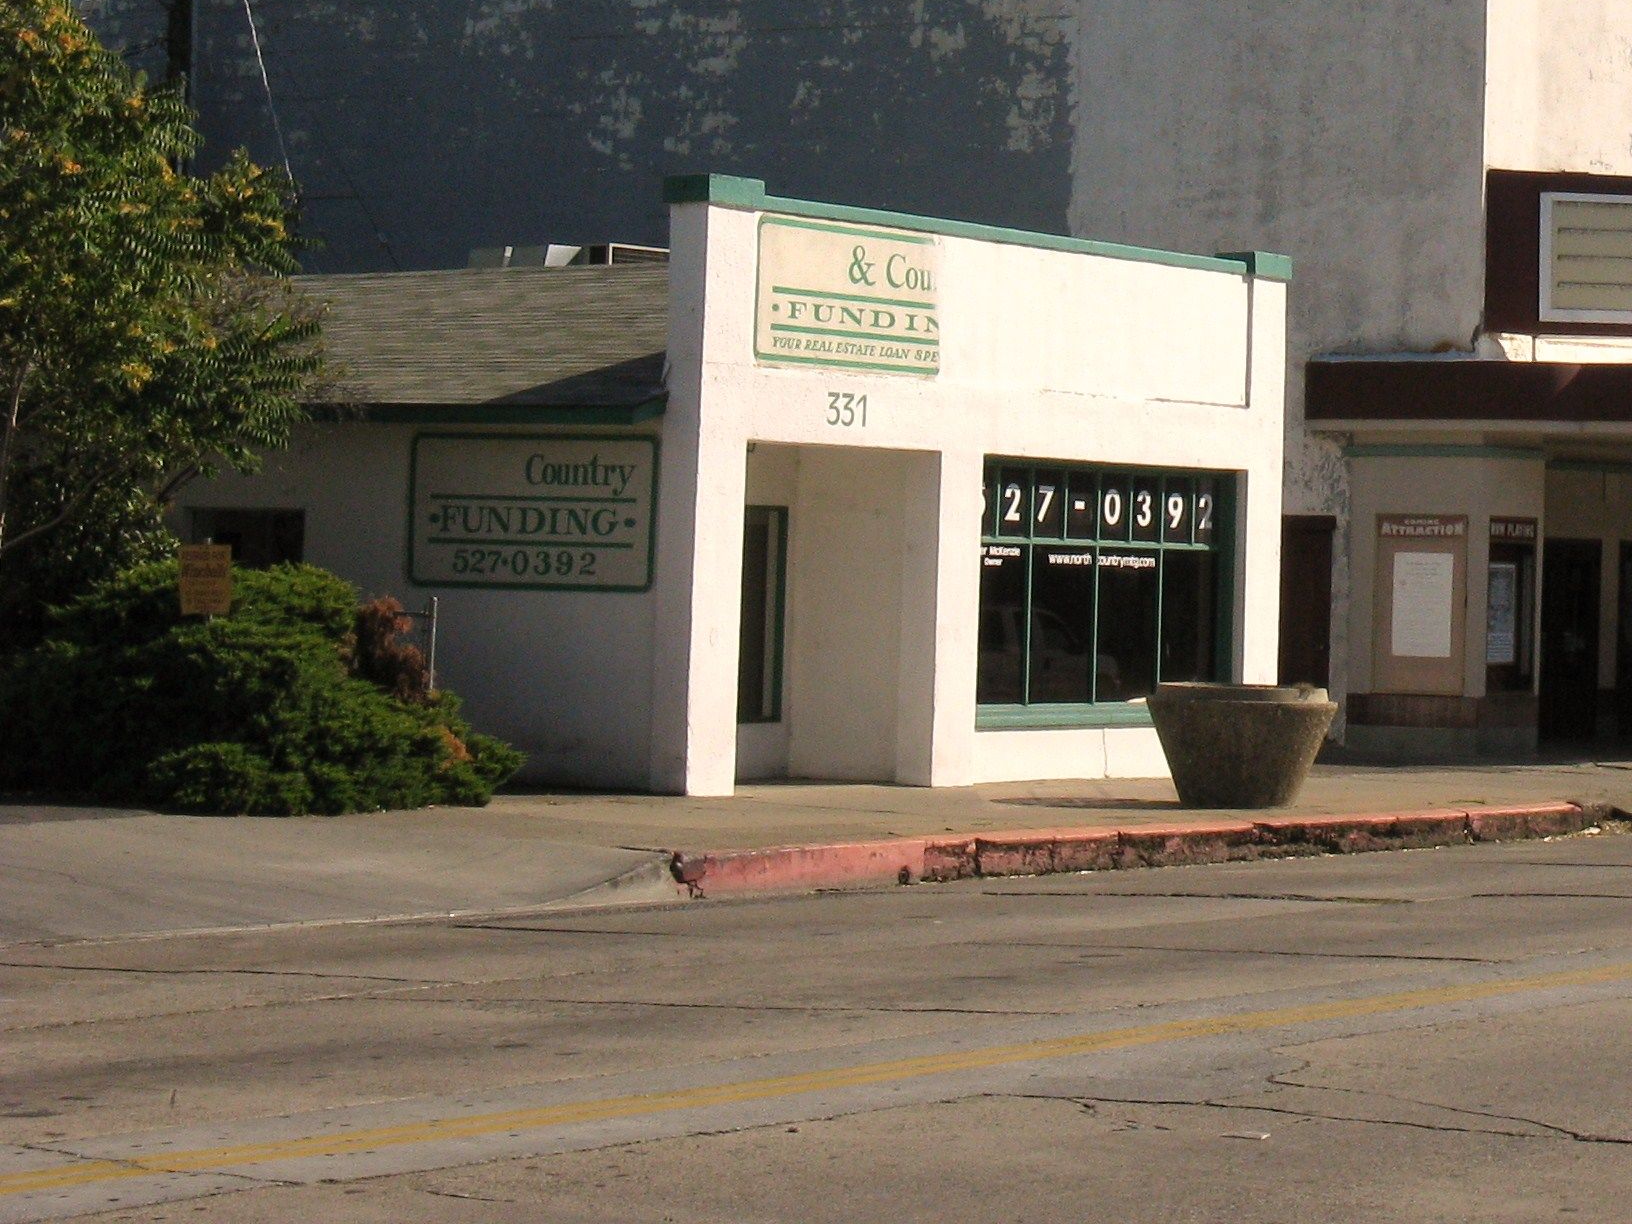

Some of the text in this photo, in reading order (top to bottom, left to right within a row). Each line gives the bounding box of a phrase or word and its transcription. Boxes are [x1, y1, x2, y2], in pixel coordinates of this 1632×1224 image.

[849, 245, 876, 287] &
[772, 336, 802, 350] YOUR
[804, 338, 834, 353] REAL
[835, 342, 876, 357] ESTATE
[879, 346, 911, 360] LOAN
[826, 391, 868, 427] 331
[525, 453, 637, 496] Country
[439, 504, 619, 536] FUNDING
[1382, 522, 1464, 536] ATTRACTION
